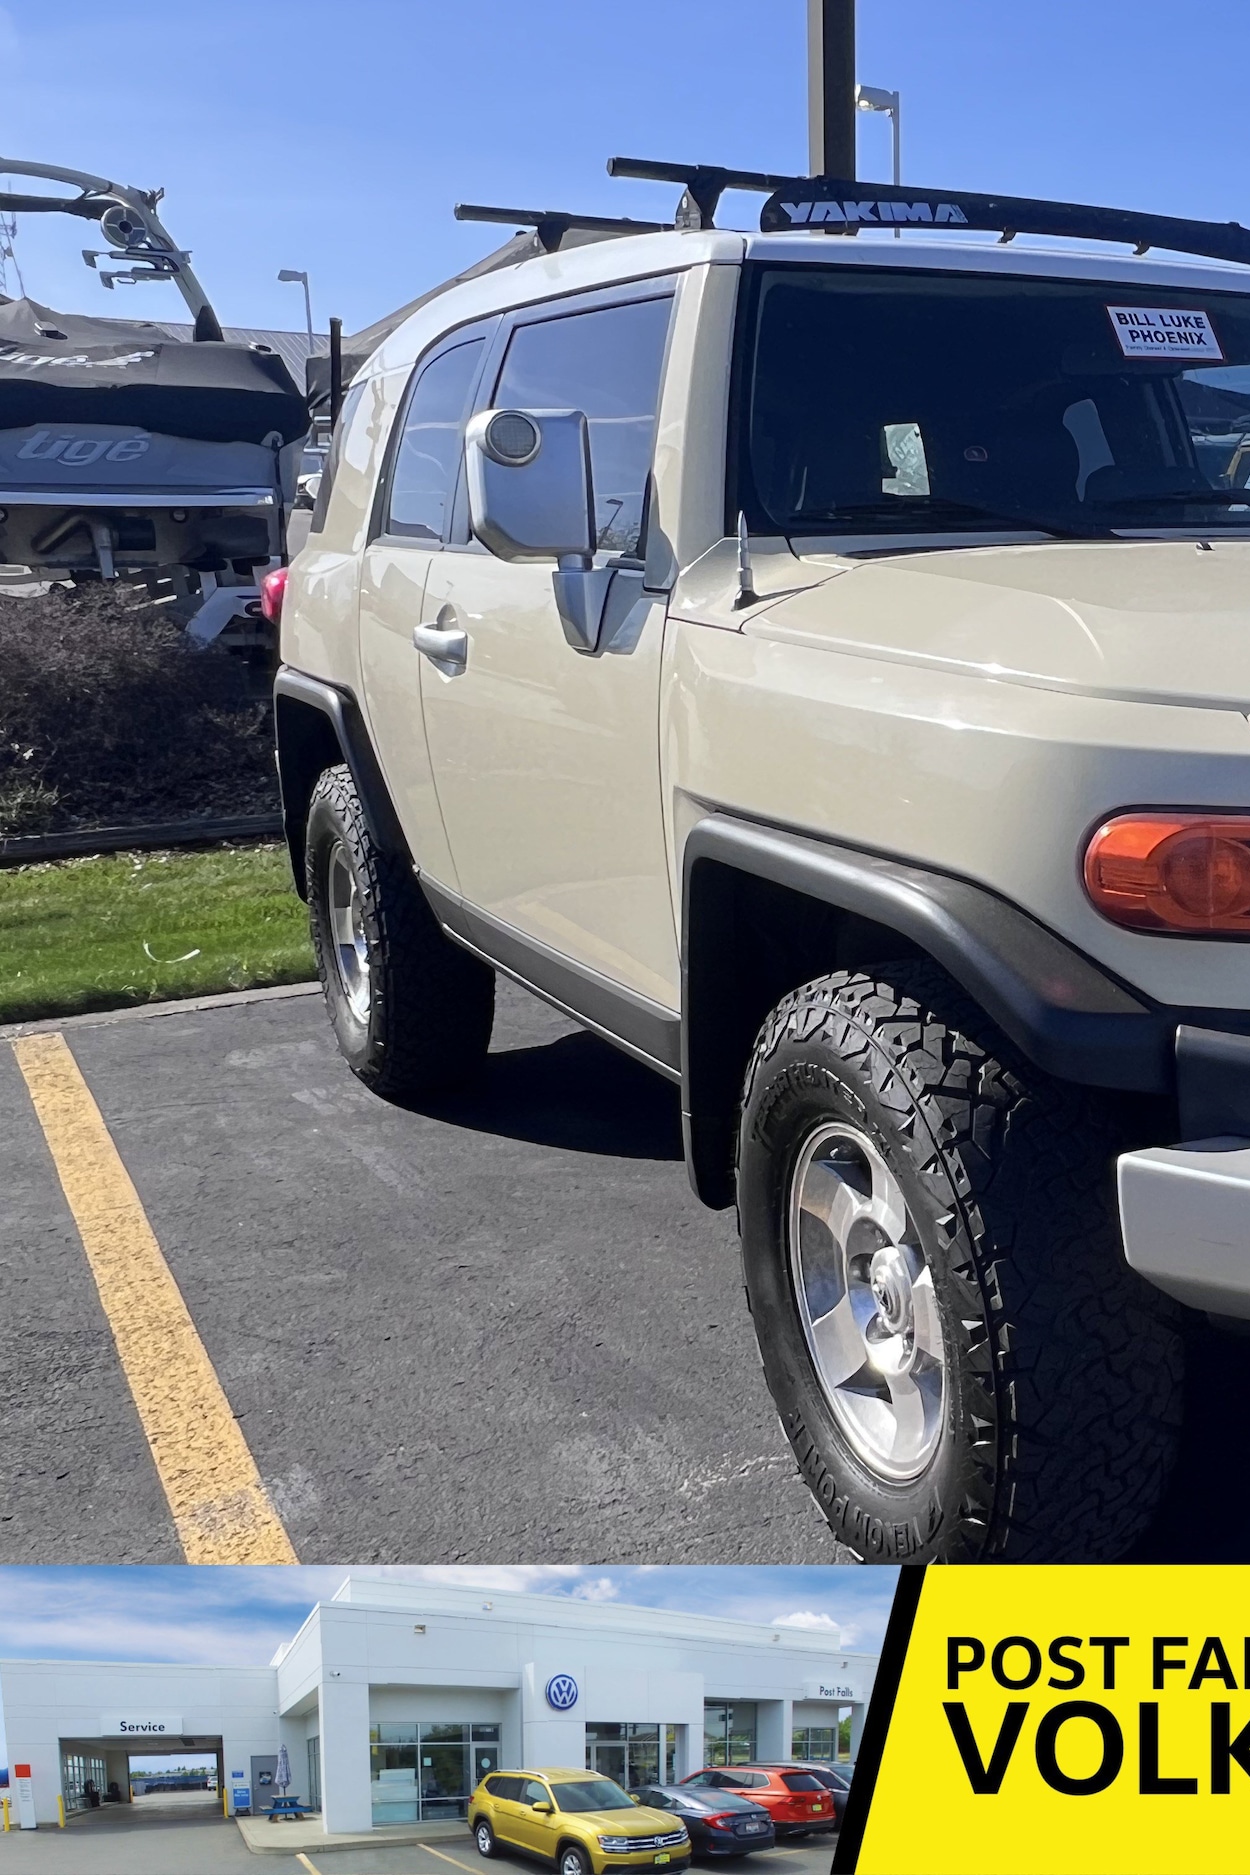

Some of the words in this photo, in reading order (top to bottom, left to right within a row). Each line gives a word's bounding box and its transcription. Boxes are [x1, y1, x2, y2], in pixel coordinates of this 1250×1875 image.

[780, 201, 969, 224] YAKIMA
[1115, 311, 1156, 327] BILL
[1159, 313, 1206, 329] LUKE
[1128, 329, 1208, 346] PHOENIX
[16, 430, 152, 467] tigé
[819, 1685, 835, 1697] Post
[836, 1686, 854, 1697] Falls
[120, 1721, 165, 1732] Service
